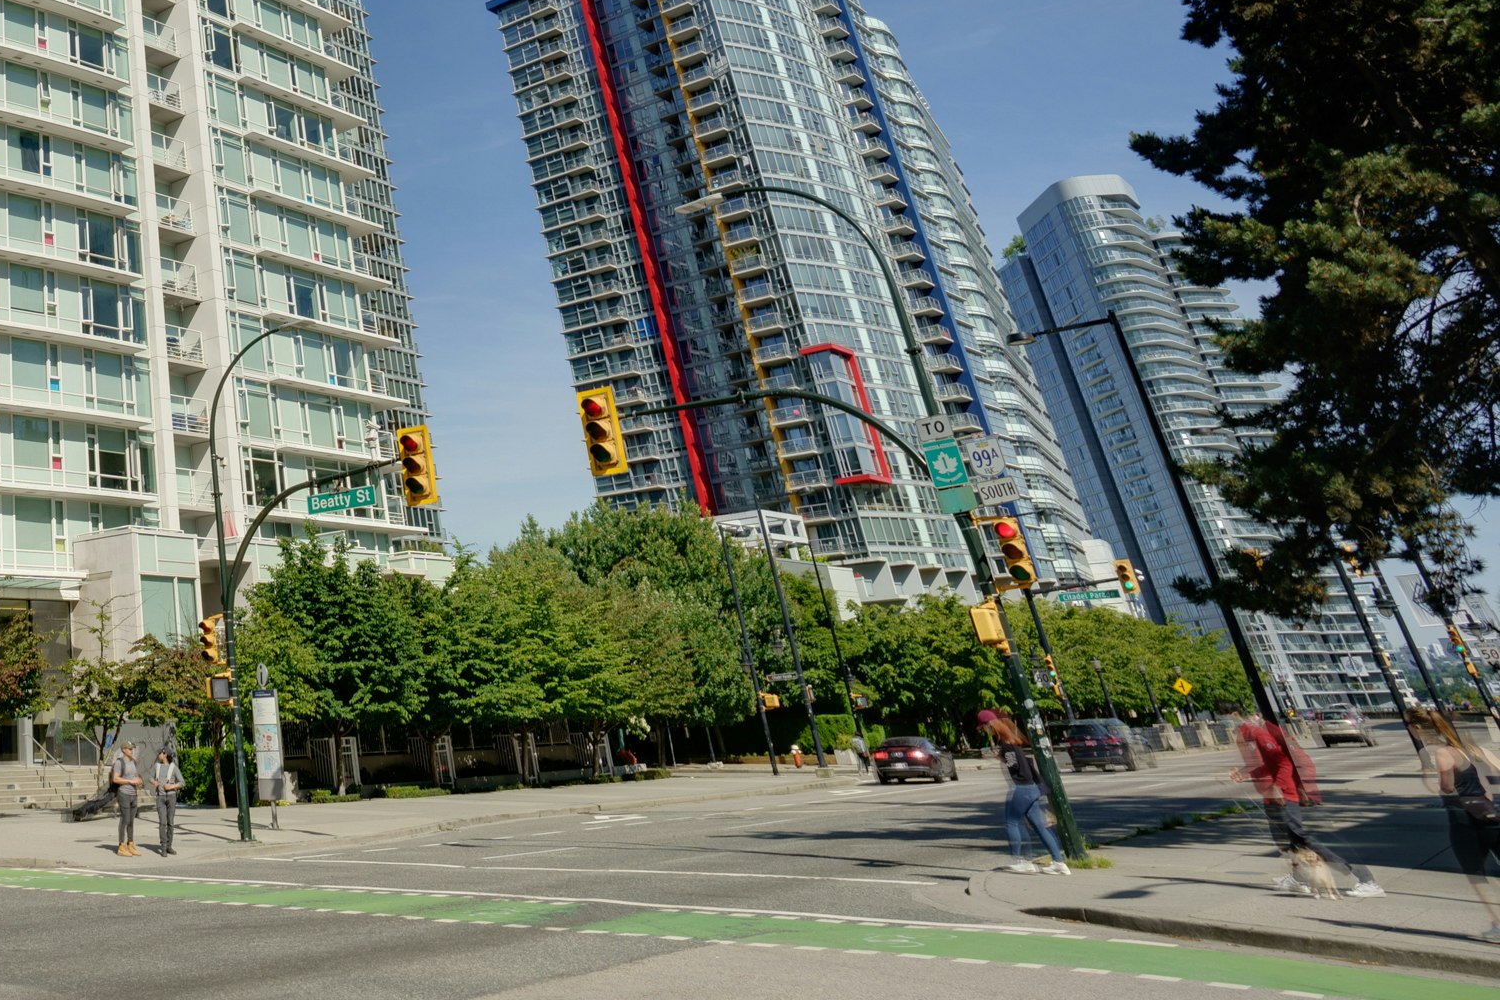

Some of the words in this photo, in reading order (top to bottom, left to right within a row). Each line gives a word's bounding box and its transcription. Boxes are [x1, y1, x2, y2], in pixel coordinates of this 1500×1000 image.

[922, 421, 945, 436] TO
[941, 457, 948, 469] 1
[972, 448, 999, 468] 99A
[980, 482, 1016, 500] SOUTH
[311, 493, 351, 510] Beatty
[356, 489, 371, 503] St
[1062, 592, 1088, 601] Citadel
[1481, 649, 1499, 660] 50
